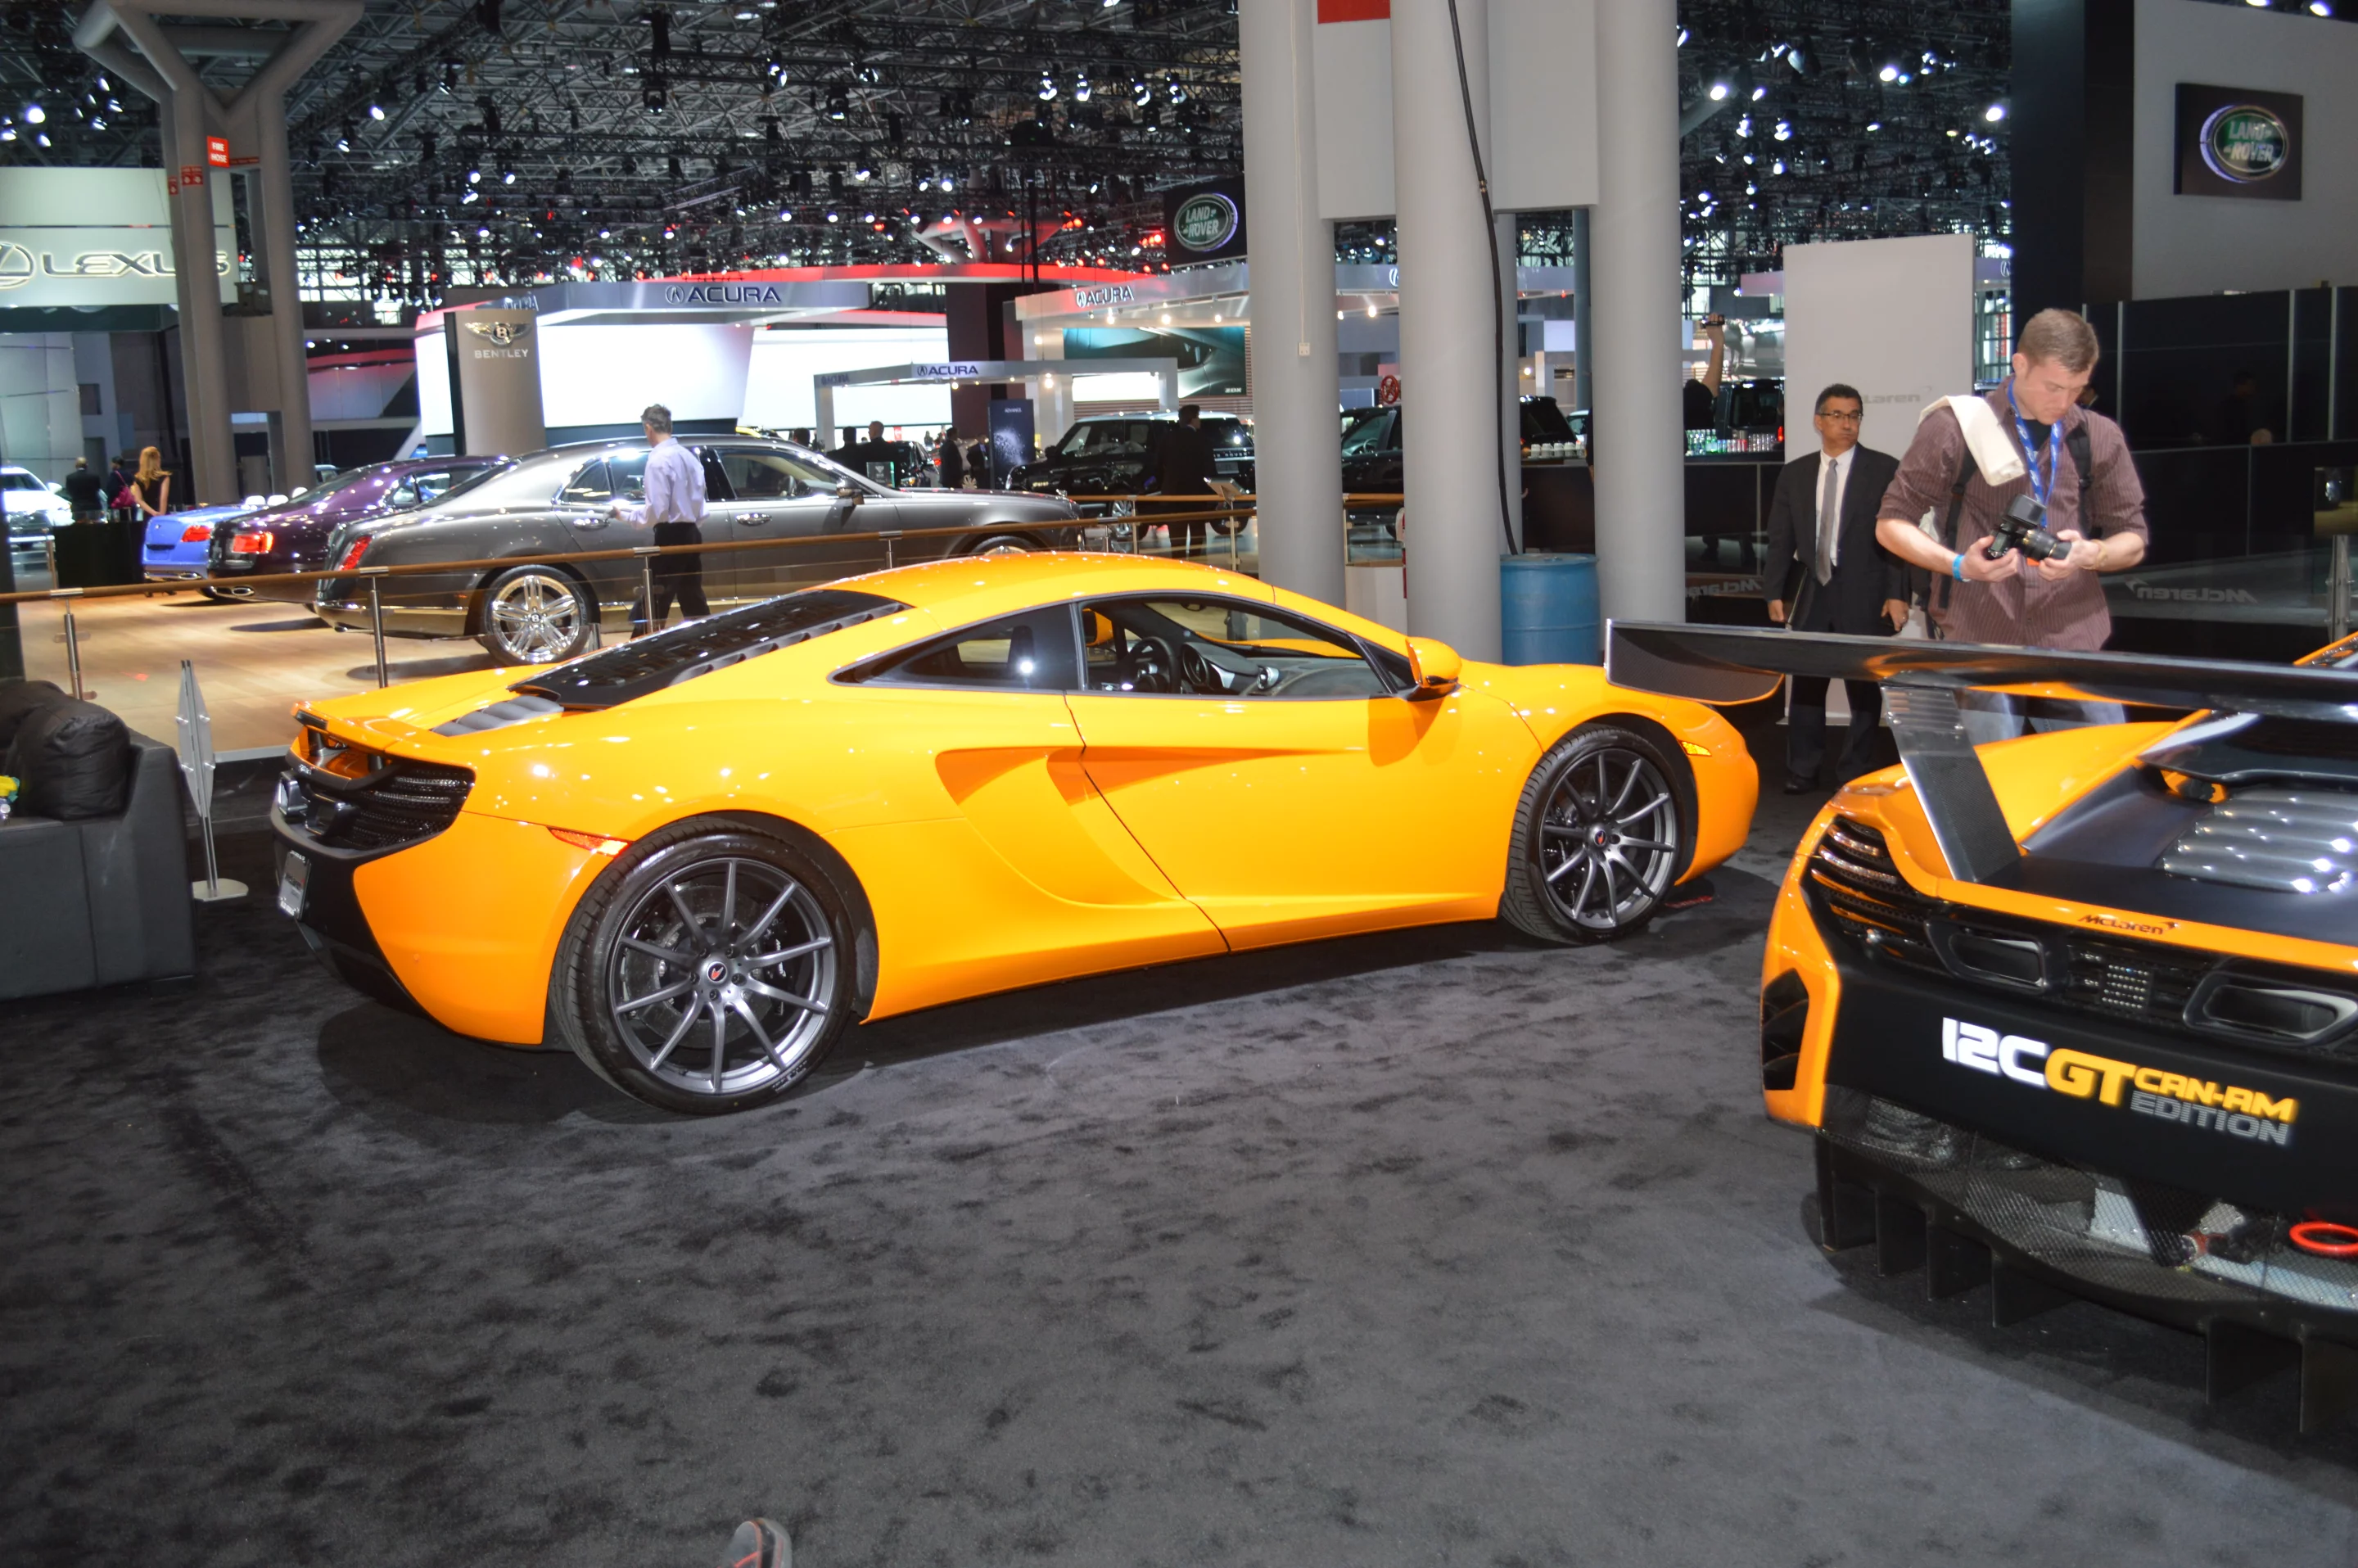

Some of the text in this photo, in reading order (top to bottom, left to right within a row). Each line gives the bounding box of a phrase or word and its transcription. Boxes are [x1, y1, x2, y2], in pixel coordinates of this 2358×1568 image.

[2229, 120, 2265, 140] LAND
[211, 141, 225, 152] FIRE
[2230, 142, 2274, 162] ROVER
[210, 152, 228, 163] HOSE
[1186, 206, 1211, 224] LAND
[1188, 219, 1220, 237] ROVER
[686, 286, 782, 303] ACURA
[1086, 285, 1135, 306] ACURA
[474, 349, 529, 359] BENTLEY
[928, 365, 979, 376] ACURA
[1863, 393, 1921, 404] Laren
[2077, 914, 2164, 935] McLaren
[2134, 1066, 2297, 1123] CAN-AM
[2130, 1090, 2289, 1145] EDITION
